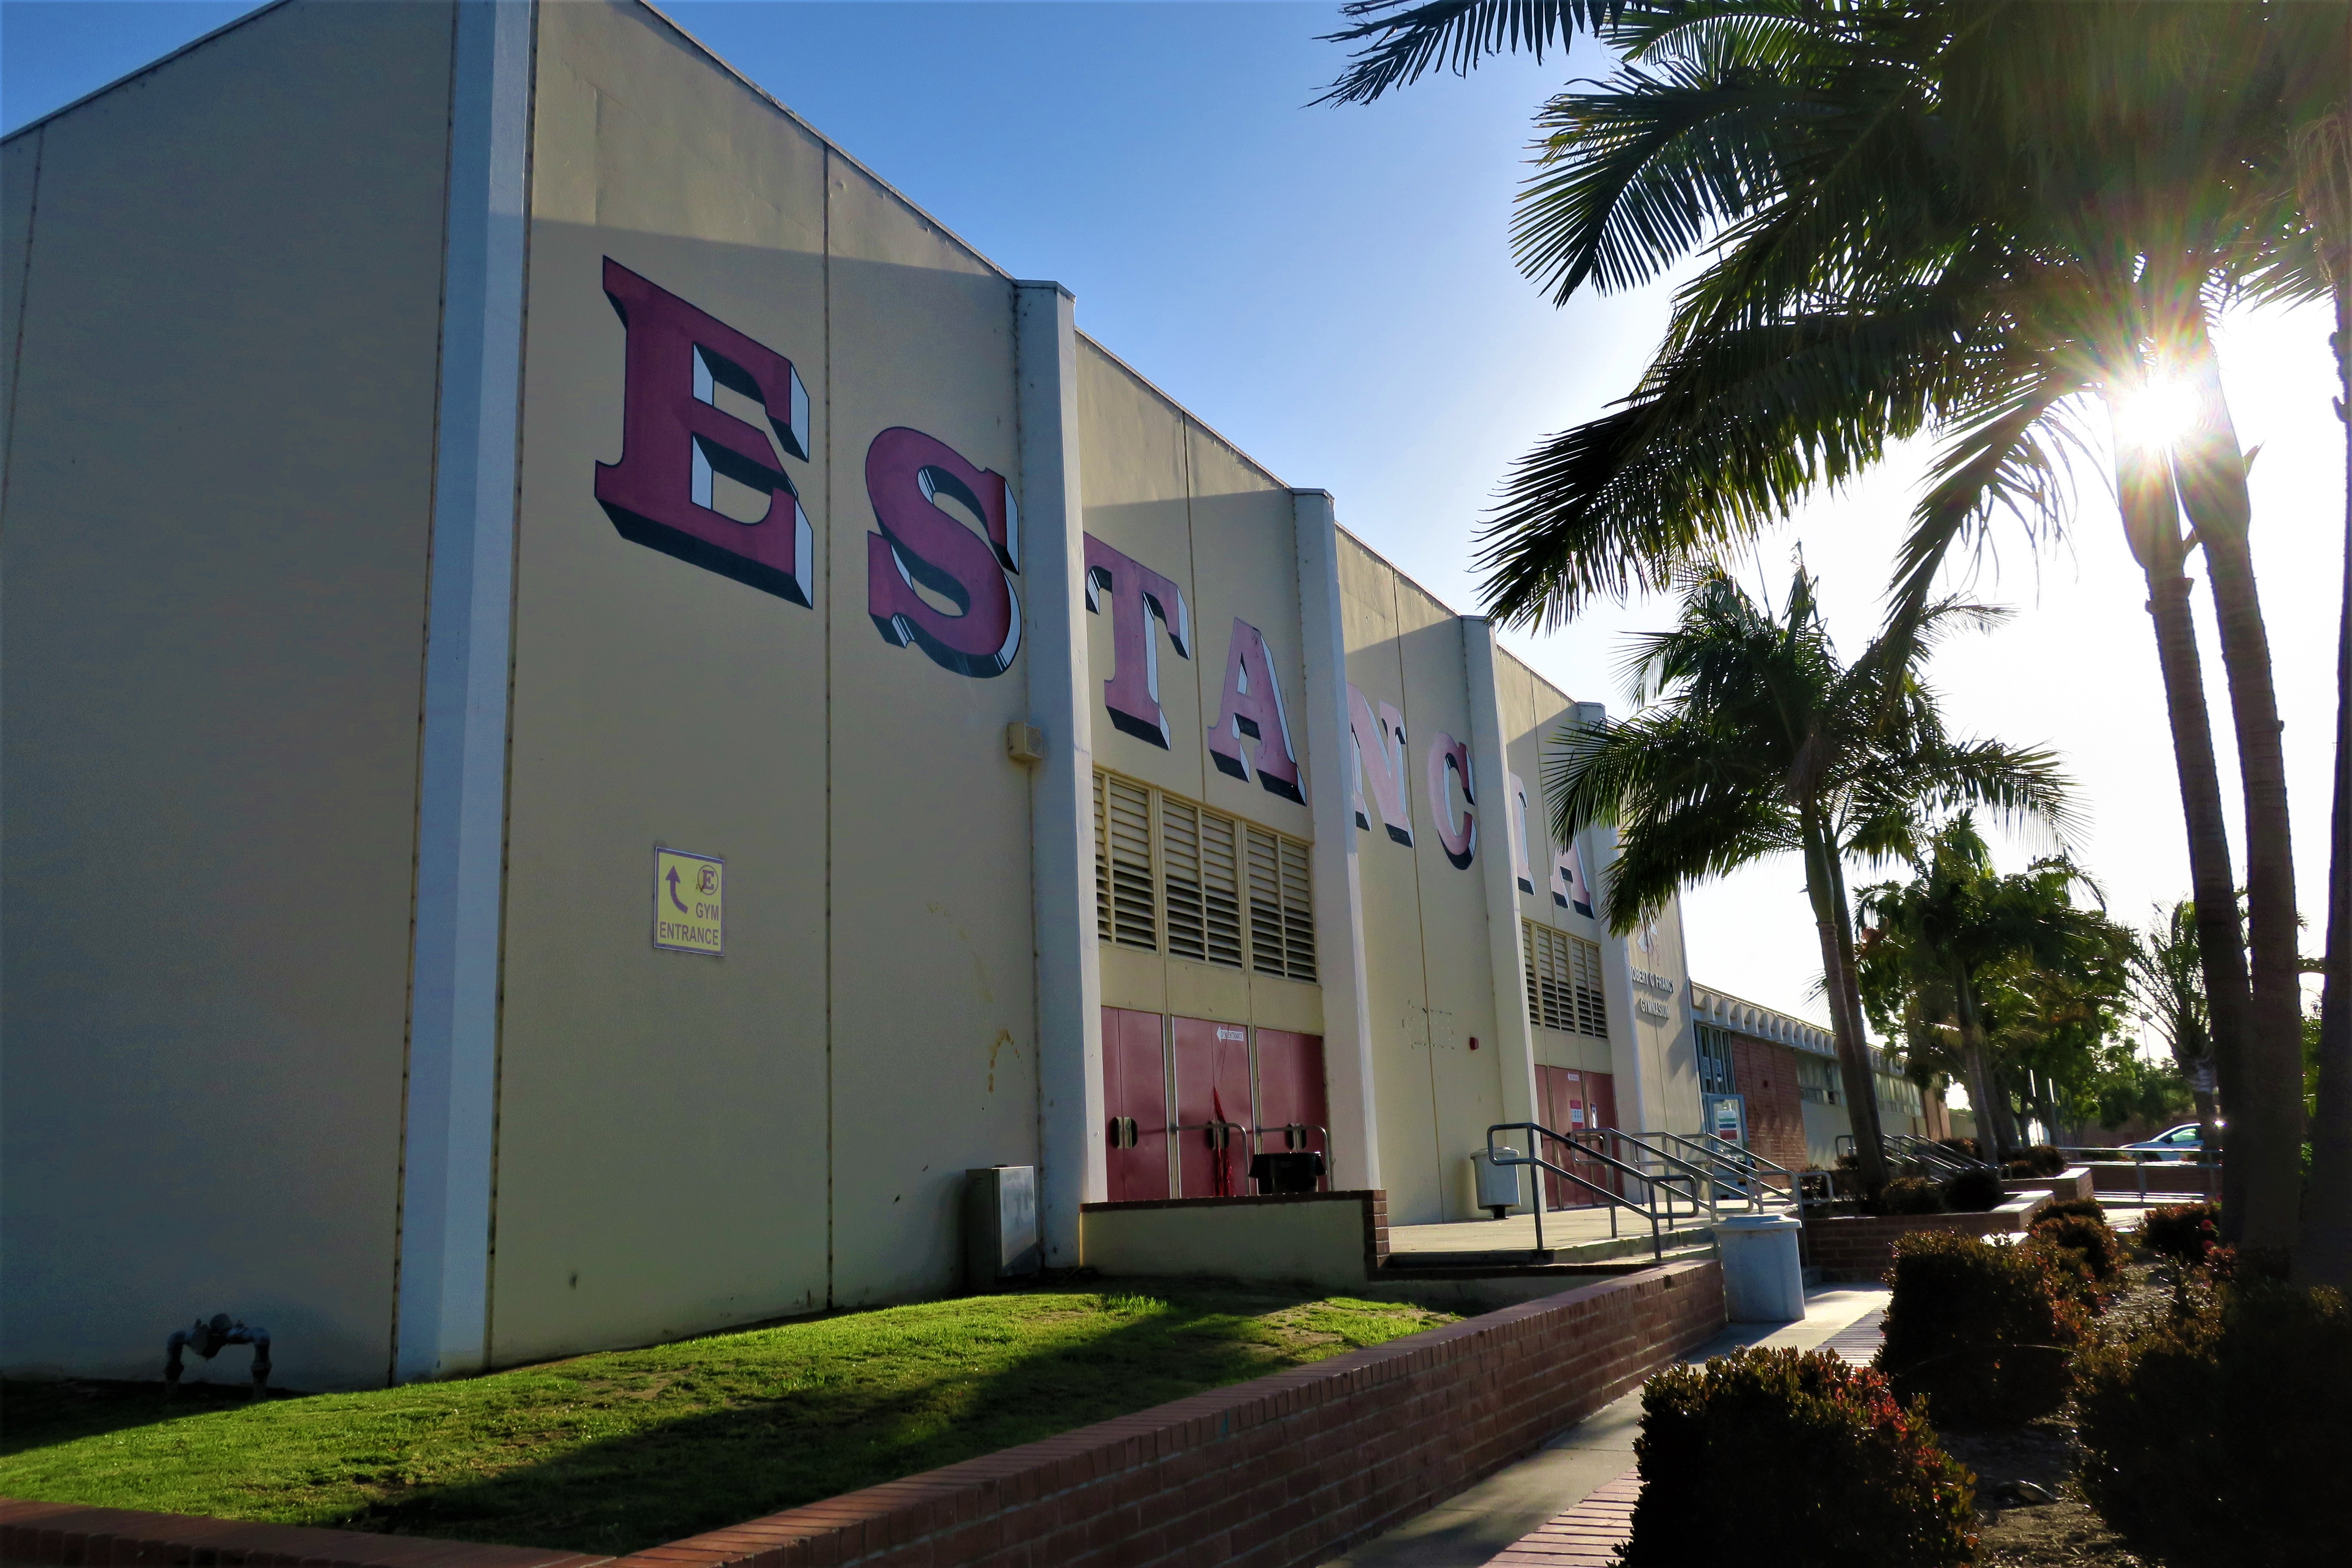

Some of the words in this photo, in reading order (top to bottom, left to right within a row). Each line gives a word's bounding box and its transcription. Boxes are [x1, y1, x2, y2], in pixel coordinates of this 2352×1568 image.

[702, 869, 714, 890] E
[695, 902, 719, 922] GYM
[659, 922, 719, 946] ENTRANCE
[1656, 974, 1675, 993] FRANCY
[1641, 997, 1670, 1019] GYMNASIUM
[1228, 1032, 1243, 1040] ENTRANCE
